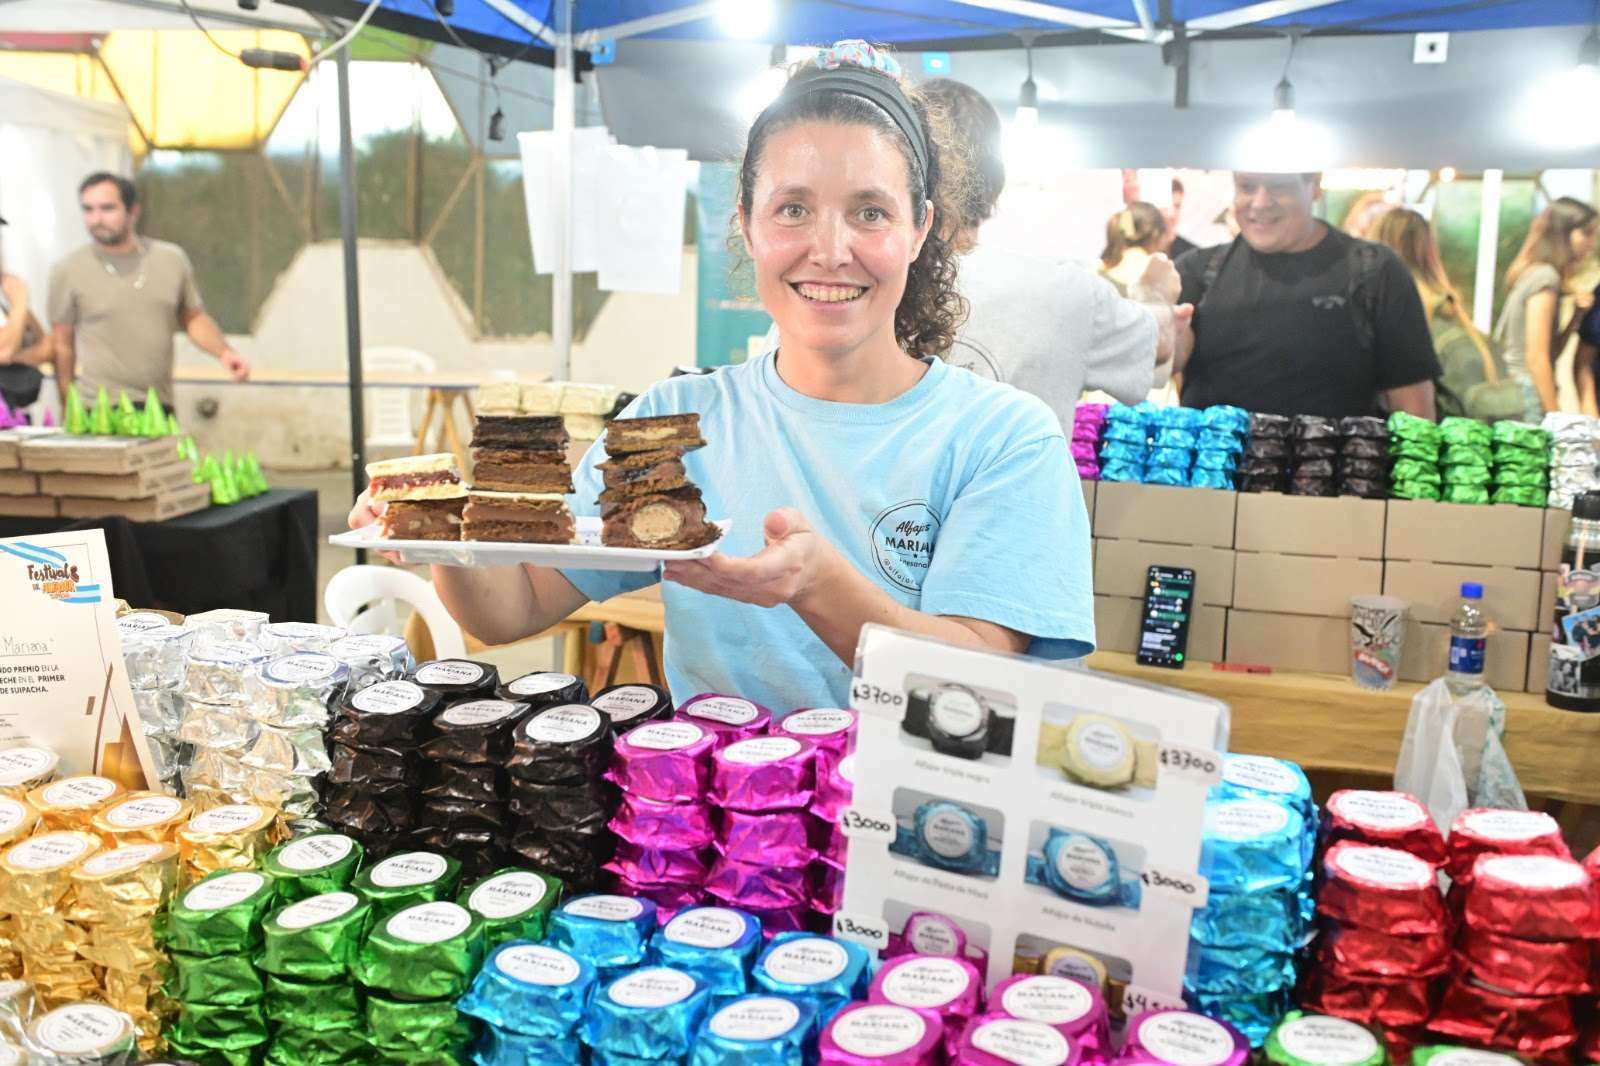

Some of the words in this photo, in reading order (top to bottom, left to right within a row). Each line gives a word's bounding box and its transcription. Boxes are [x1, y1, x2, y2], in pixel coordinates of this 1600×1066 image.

[27, 563, 69, 581] Festival
[14, 665, 40, 673] PREMIO
[435, 666, 472, 676] MARIANA
[38, 674, 65, 682] PRIMER
[11, 686, 48, 694] SUIPACHA.
[373, 689, 412, 700] MARIANA
[853, 684, 903, 705] $3700
[607, 695, 646, 704] MARIANA
[545, 714, 588, 726] MARIANA
[1161, 749, 1215, 773] $3700
[843, 811, 890, 832] $3000
[390, 862, 433, 874] MARIANA
[1141, 870, 1196, 894] $3000
[488, 885, 532, 898] MARIANA
[684, 919, 731, 934] MARIANA
[837, 918, 882, 939] $3000
[784, 952, 833, 965] MARIANA
